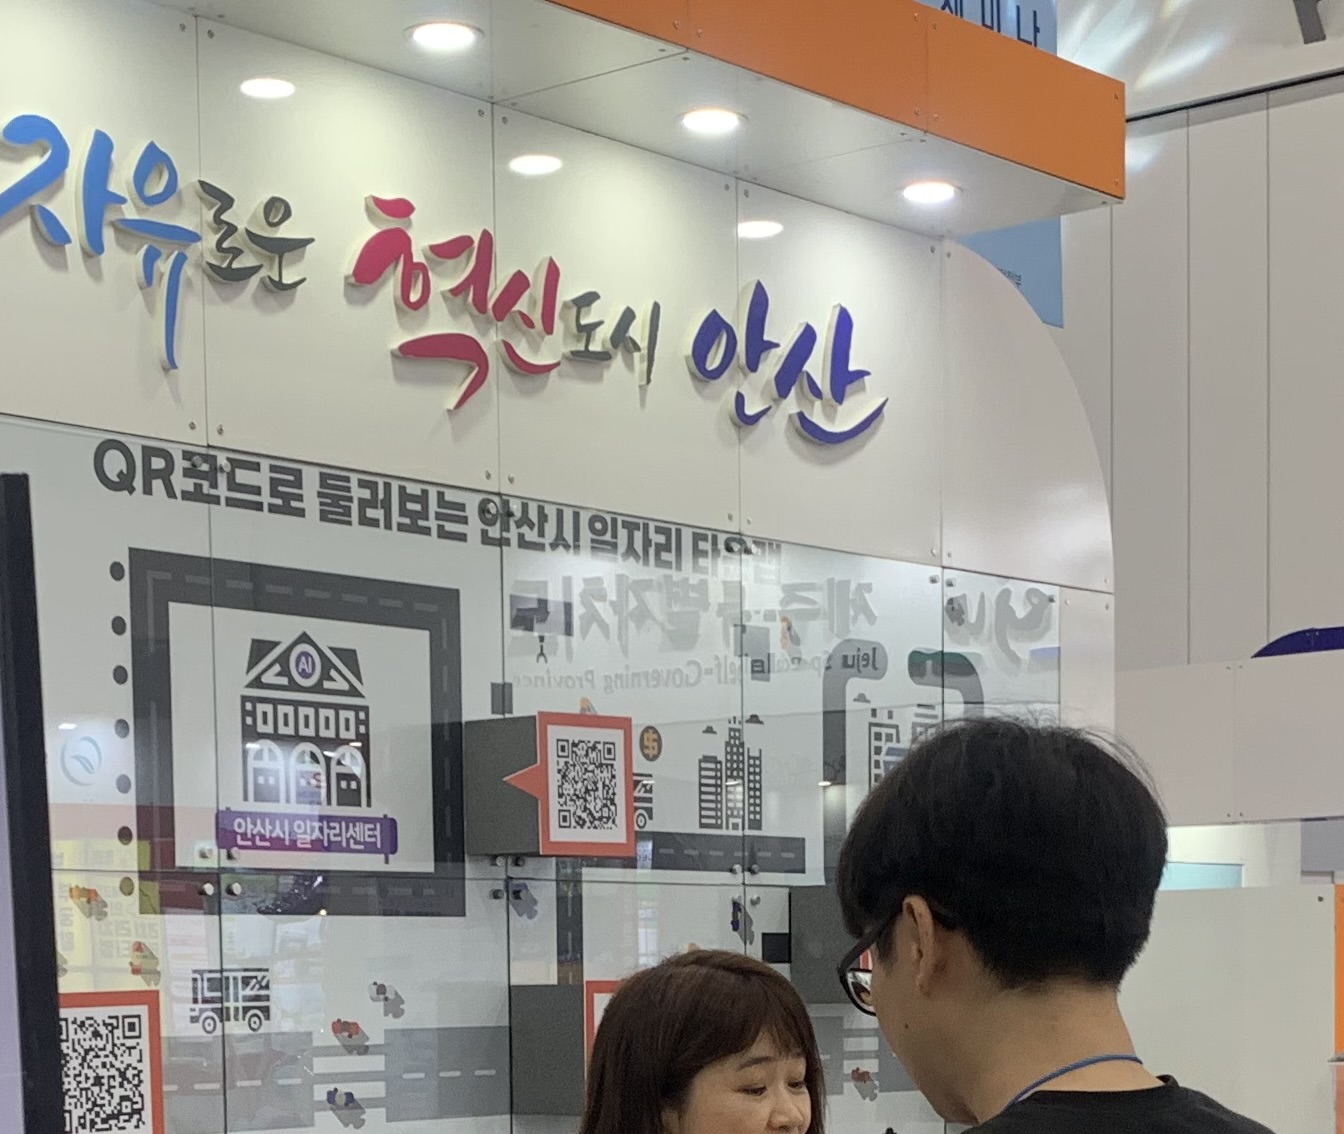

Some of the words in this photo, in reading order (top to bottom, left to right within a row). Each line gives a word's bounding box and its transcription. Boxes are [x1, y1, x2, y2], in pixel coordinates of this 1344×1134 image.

[692, 280, 888, 443] 안산
[94, 438, 305, 519] QR코드로
[316, 470, 469, 543] 둘러보는
[478, 497, 580, 556] 안산시
[588, 513, 683, 573] 일자리
[298, 656, 312, 673] AI
[233, 816, 290, 847] 안산시
[293, 820, 381, 849] 일자리센터
